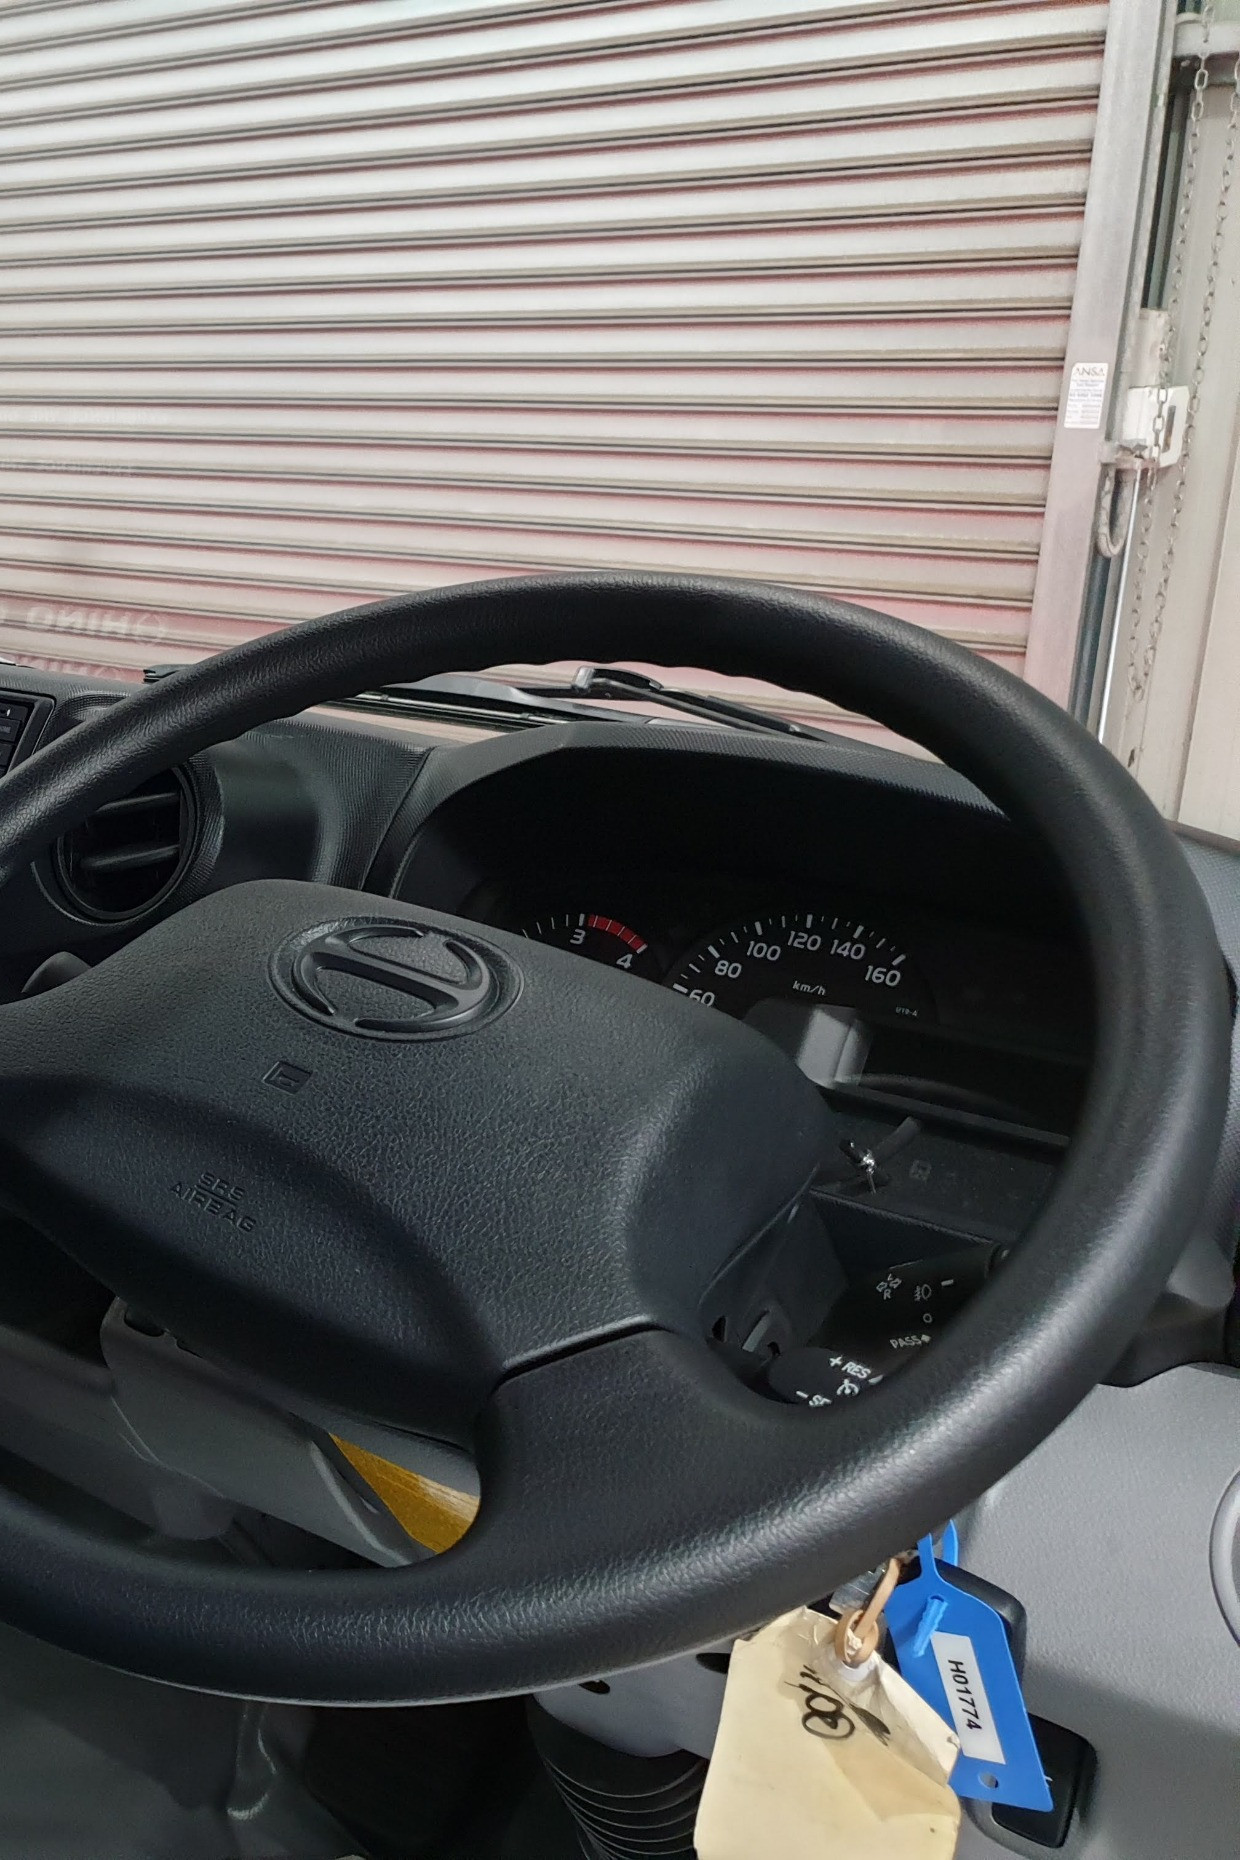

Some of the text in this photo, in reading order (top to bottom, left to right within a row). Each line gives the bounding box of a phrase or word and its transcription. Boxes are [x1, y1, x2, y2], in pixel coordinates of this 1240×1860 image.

[1072, 367, 1105, 377] ANSA
[569, 928, 586, 945] 3
[787, 930, 822, 951] 120
[746, 940, 782, 962] 100
[829, 939, 867, 960] 140
[616, 953, 633, 969] 4
[714, 959, 743, 979] 80
[864, 965, 901, 987] 160
[792, 980, 827, 996] km/h
[198, 1172, 246, 1201] SRS
[169, 1182, 257, 1233] AIRBAG
[883, 1288, 892, 1300] R
[889, 1335, 922, 1349] PASS
[841, 1361, 872, 1379] RES
[947, 1659, 983, 1731] H01774
